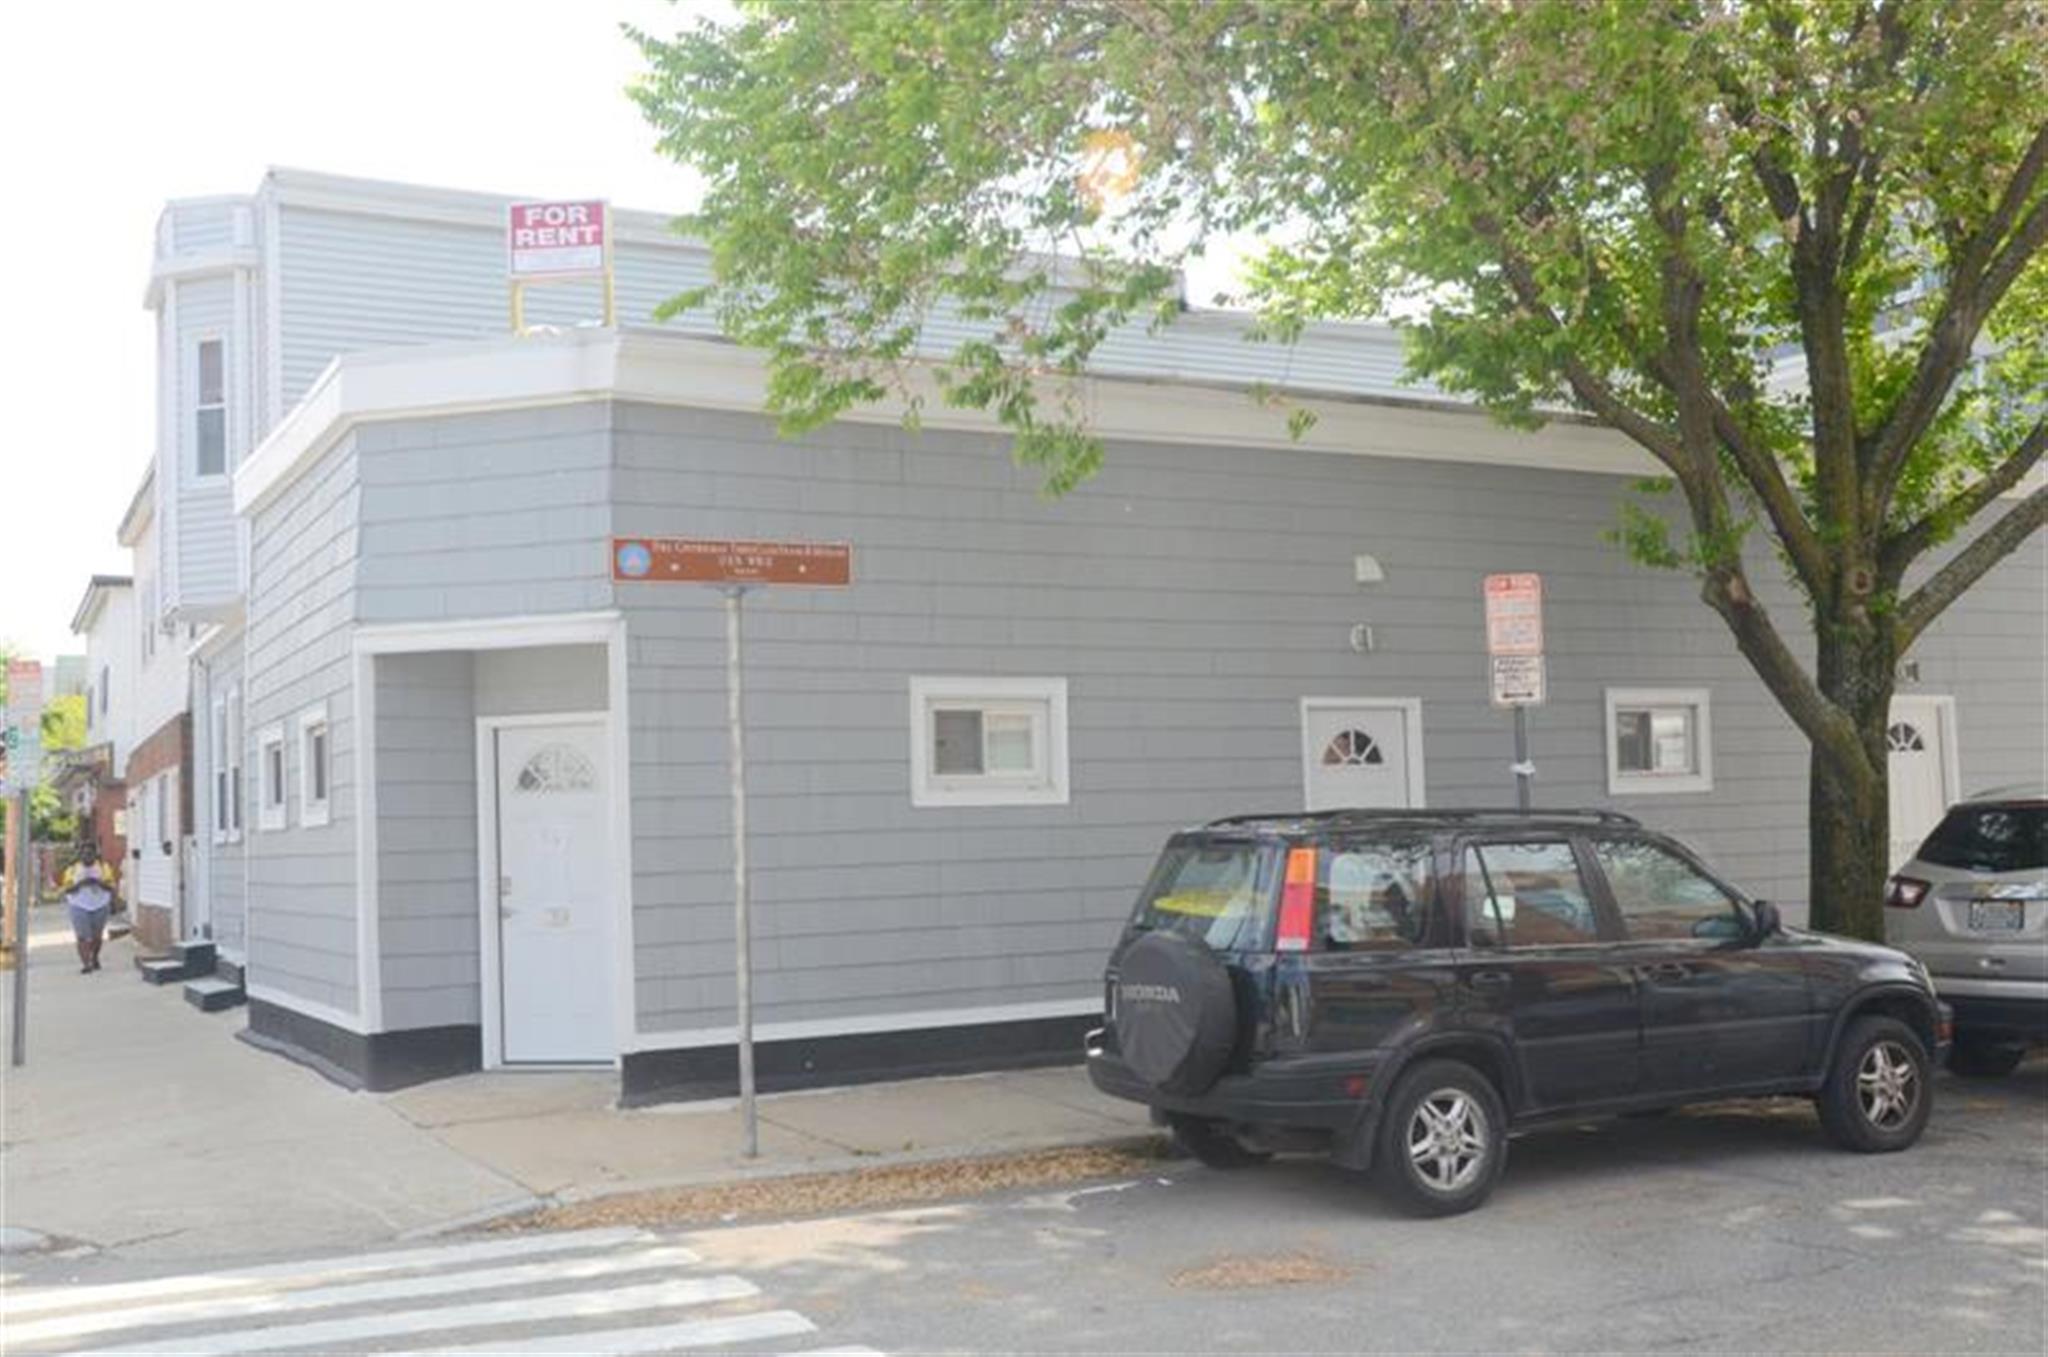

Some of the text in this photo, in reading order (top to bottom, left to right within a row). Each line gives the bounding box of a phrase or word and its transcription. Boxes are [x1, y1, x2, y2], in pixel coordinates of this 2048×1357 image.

[524, 205, 589, 226] FOR
[515, 224, 600, 246] RENT
[1121, 984, 1181, 1003] HONDA
